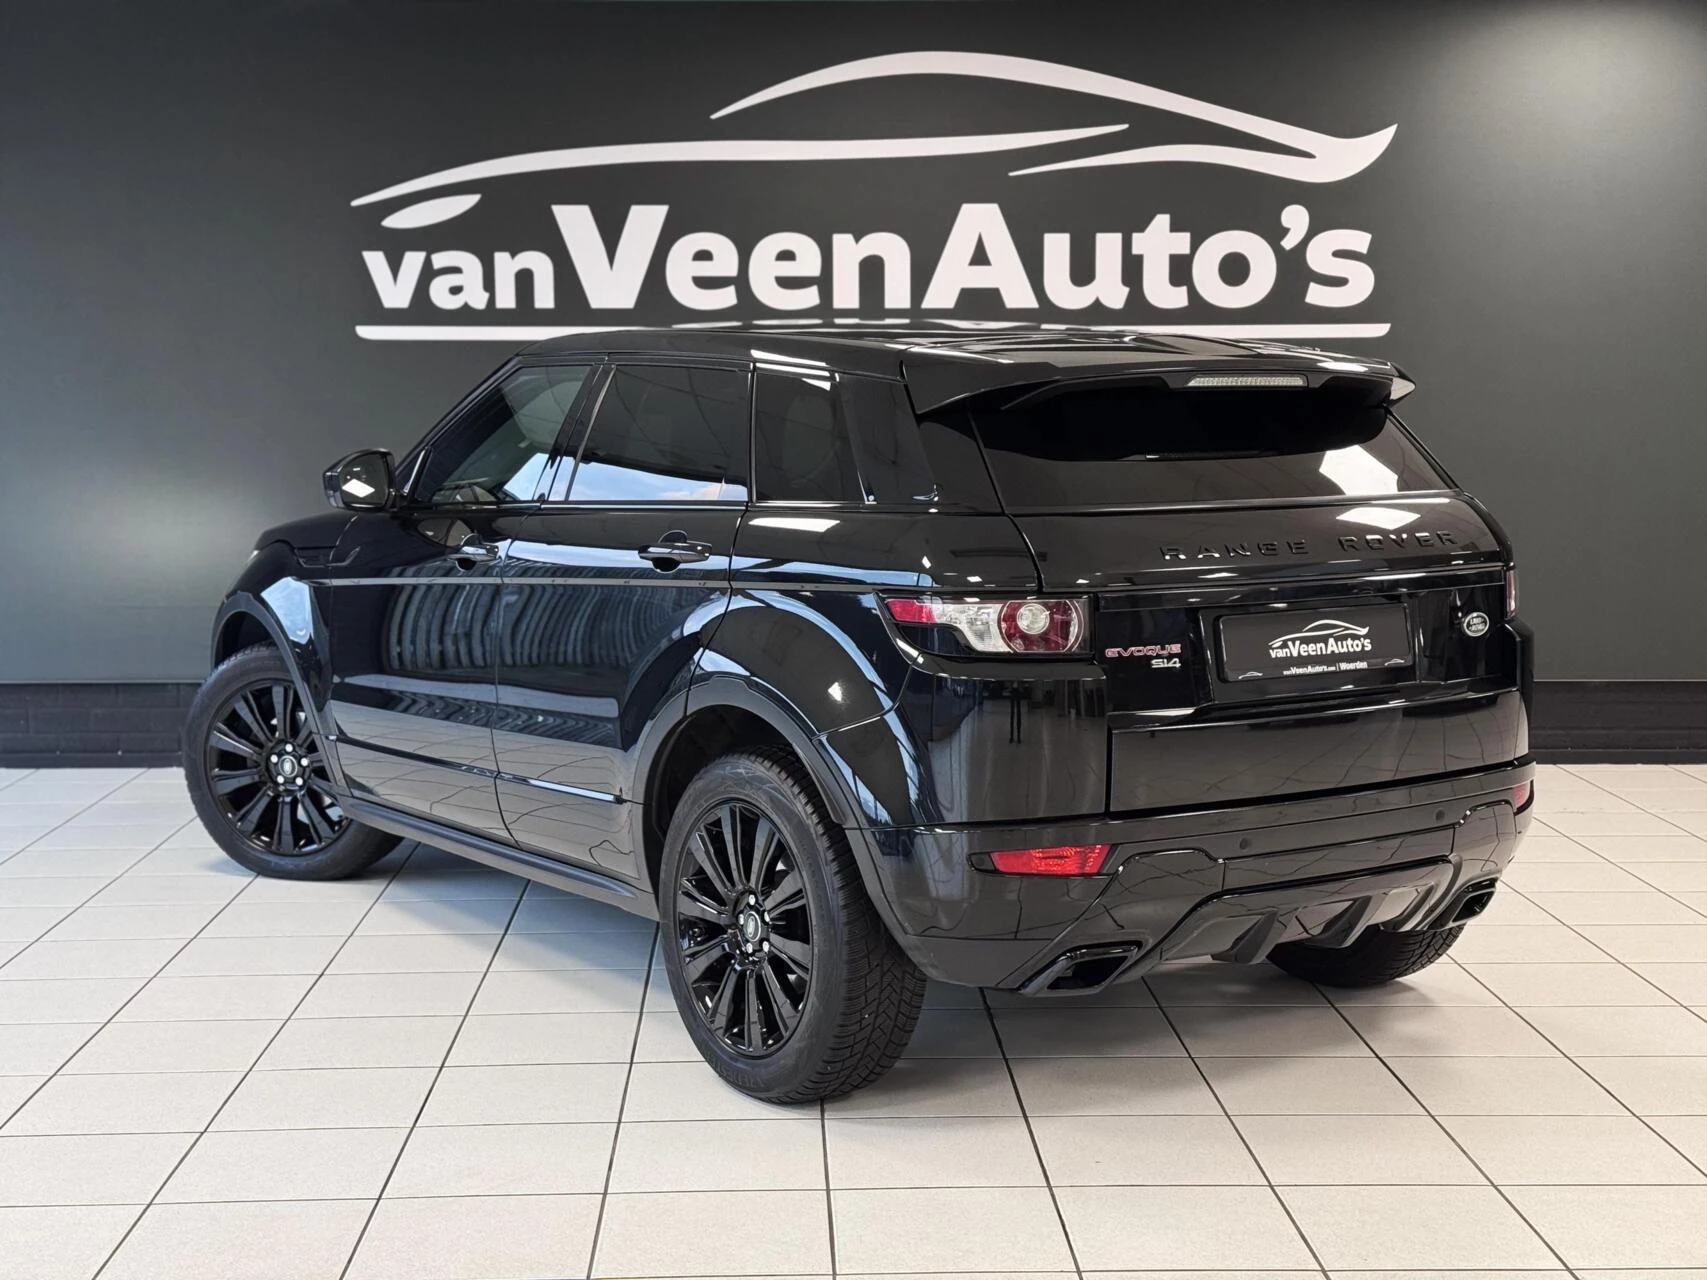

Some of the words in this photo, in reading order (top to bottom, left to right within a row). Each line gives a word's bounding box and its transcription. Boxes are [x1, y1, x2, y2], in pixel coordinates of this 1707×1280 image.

[361, 203, 1376, 310] vanVeenAuto's
[1159, 539, 1310, 560] RANGE
[1337, 530, 1457, 551] ROVER
[1105, 643, 1181, 657] EVOQUE
[1269, 638, 1372, 658] vanVeenAuto's
[1339, 661, 1368, 671] Woerden
